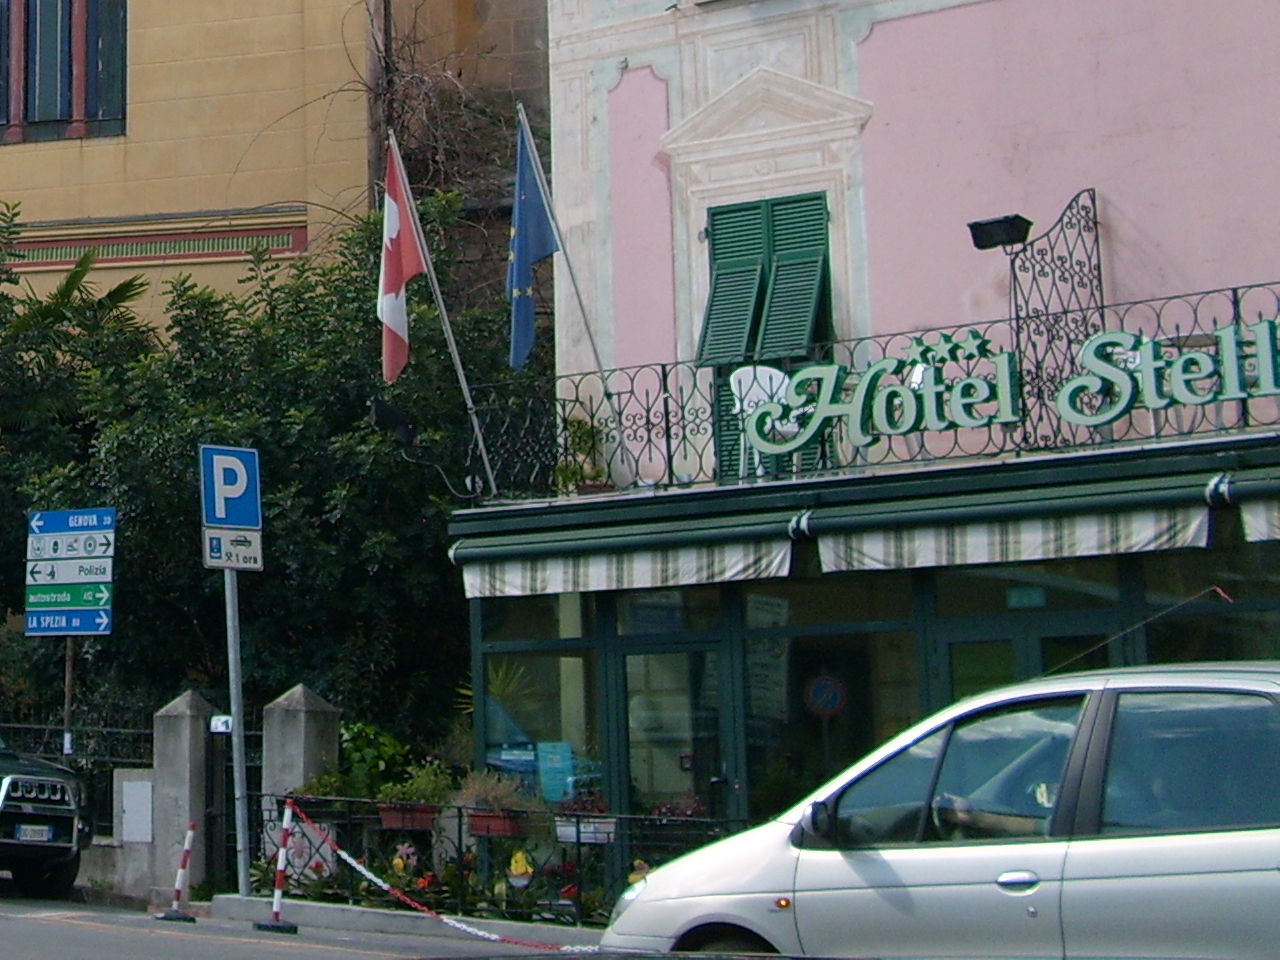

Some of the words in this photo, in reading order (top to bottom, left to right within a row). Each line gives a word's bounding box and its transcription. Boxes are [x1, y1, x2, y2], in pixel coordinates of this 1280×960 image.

[746, 351, 1020, 454] Hotel
[213, 455, 247, 518] P
[68, 514, 98, 527] GENOVA
[242, 554, 258, 564] ora
[78, 565, 107, 576] Polizia
[28, 591, 71, 603] autostrada
[28, 616, 37, 628] LA
[40, 615, 67, 628] SPEZIA
